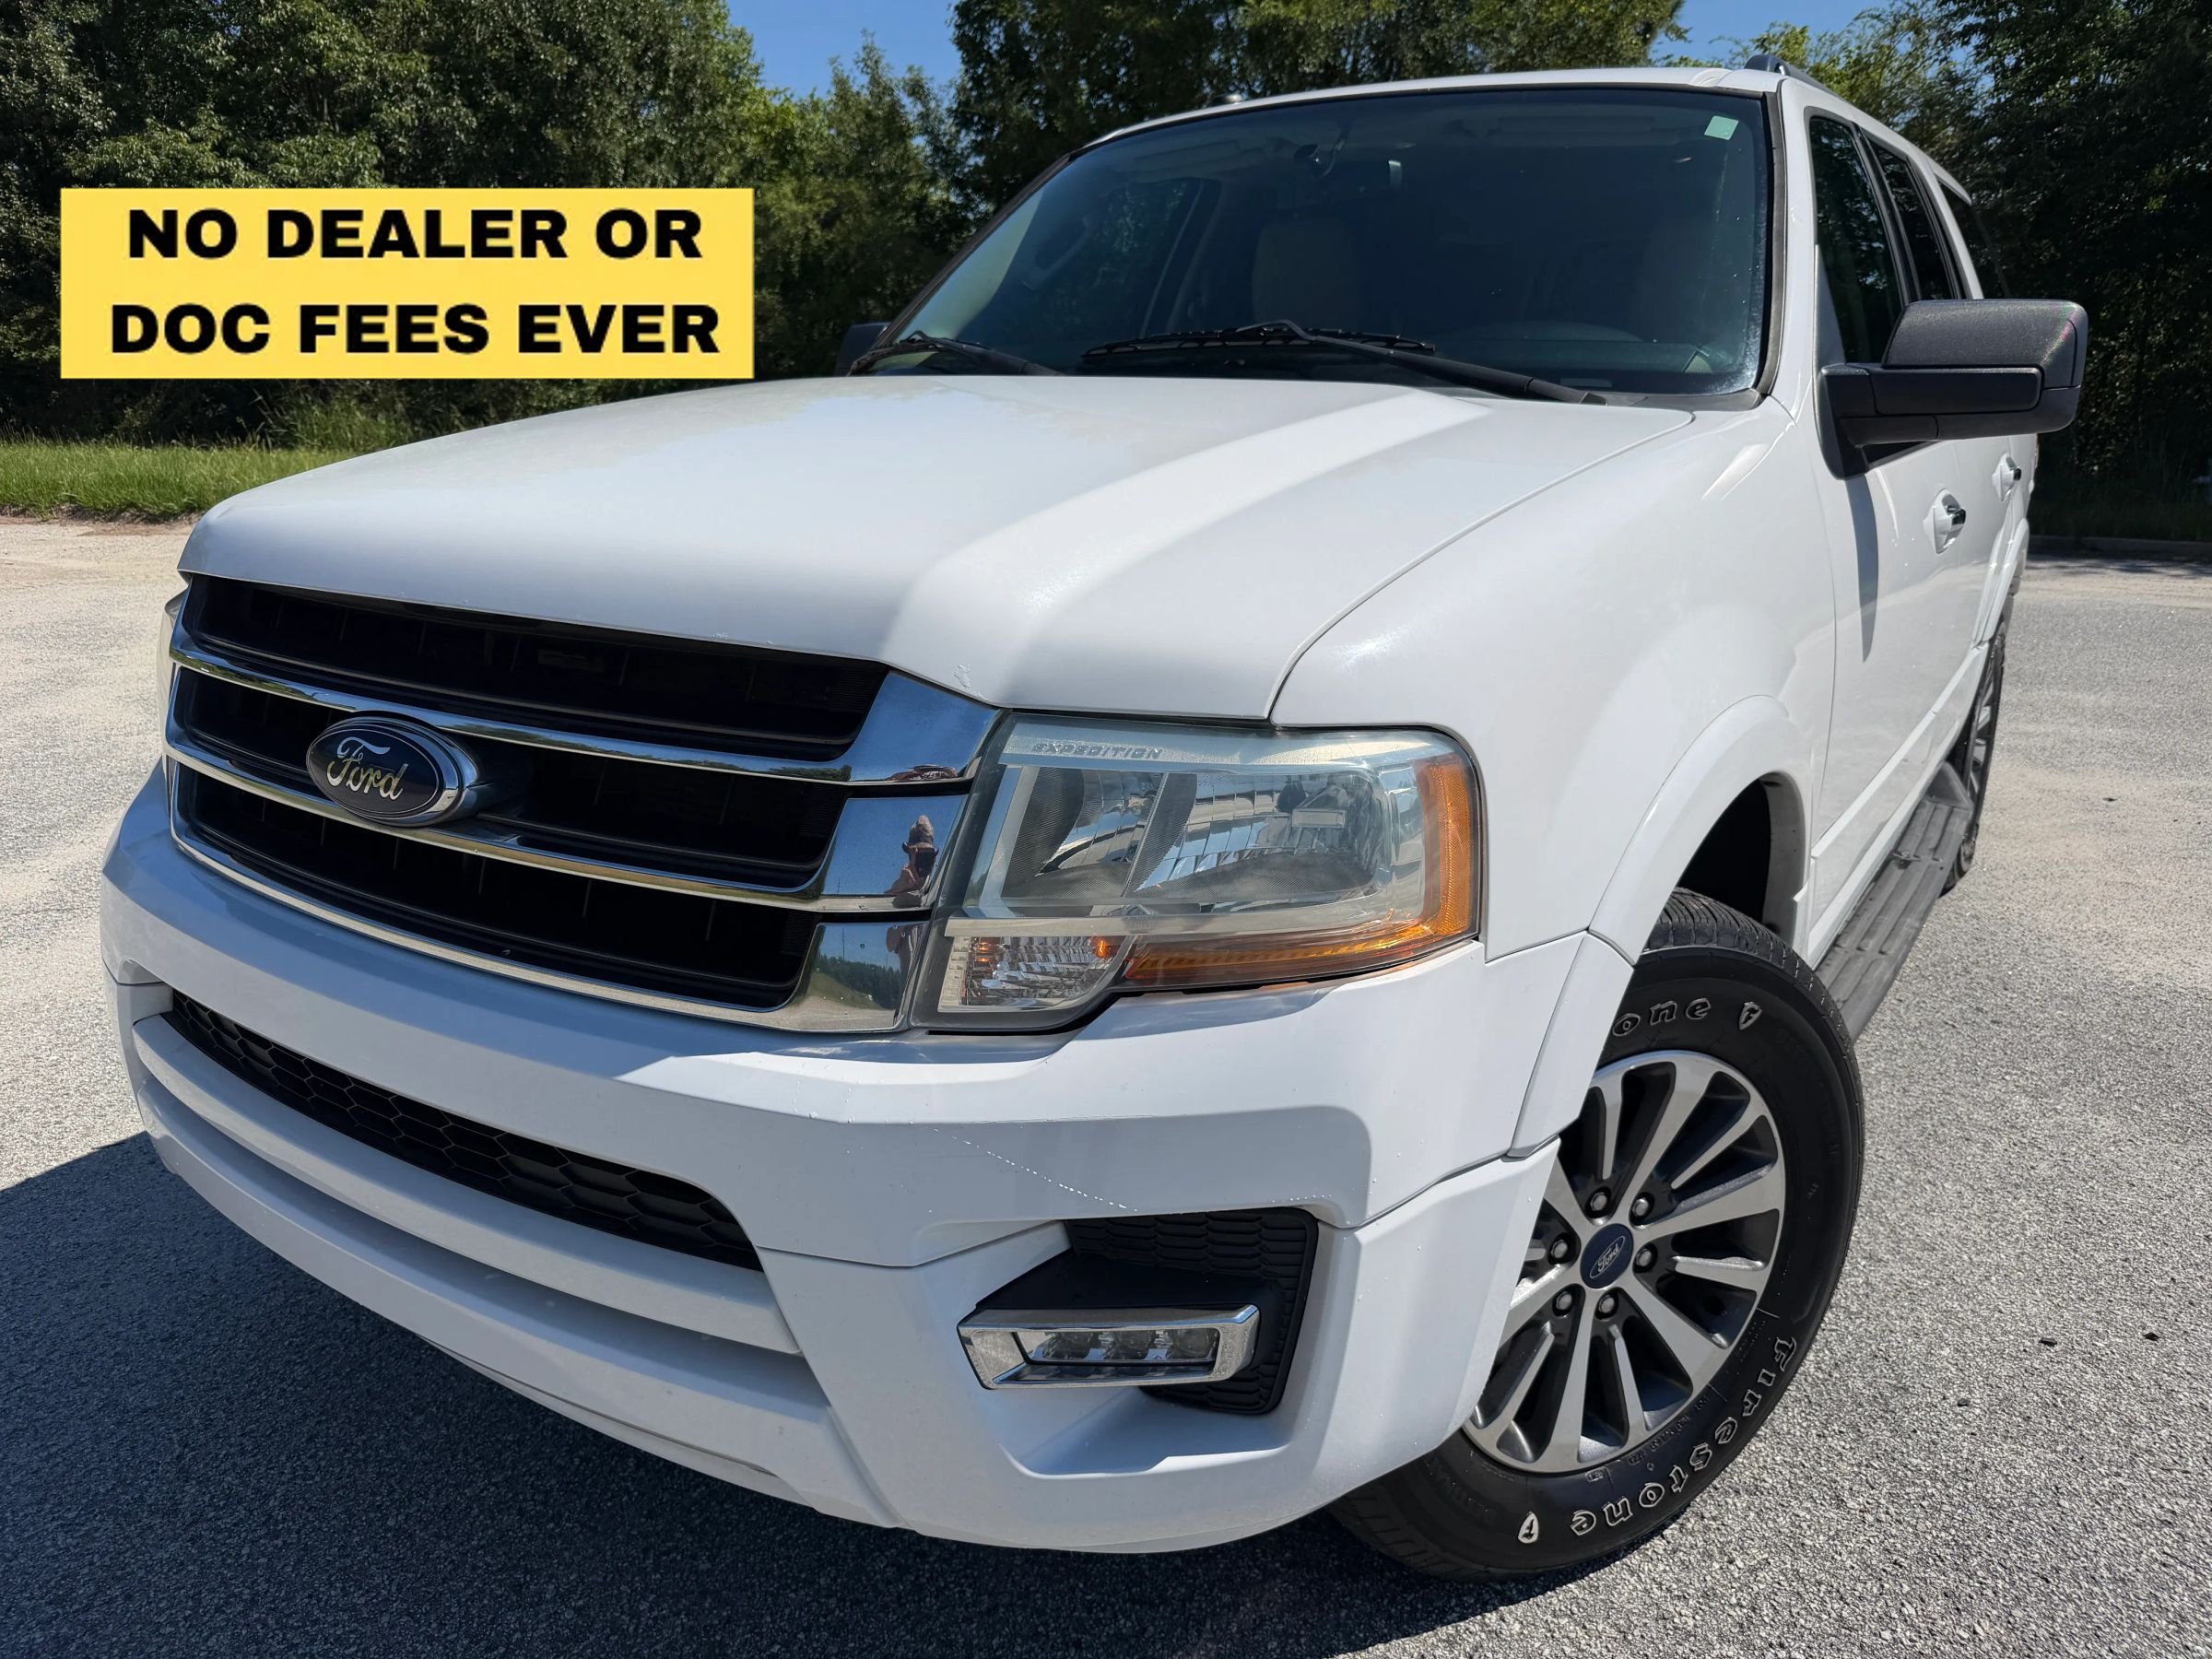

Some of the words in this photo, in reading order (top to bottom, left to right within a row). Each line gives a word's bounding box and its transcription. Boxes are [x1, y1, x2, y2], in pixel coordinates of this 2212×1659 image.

[326, 737, 409, 800] Ford
[1031, 742, 1163, 759] EXPEDITION
[1597, 1242, 1620, 1272] Ford
[1570, 1336, 1797, 1536] Firestone
